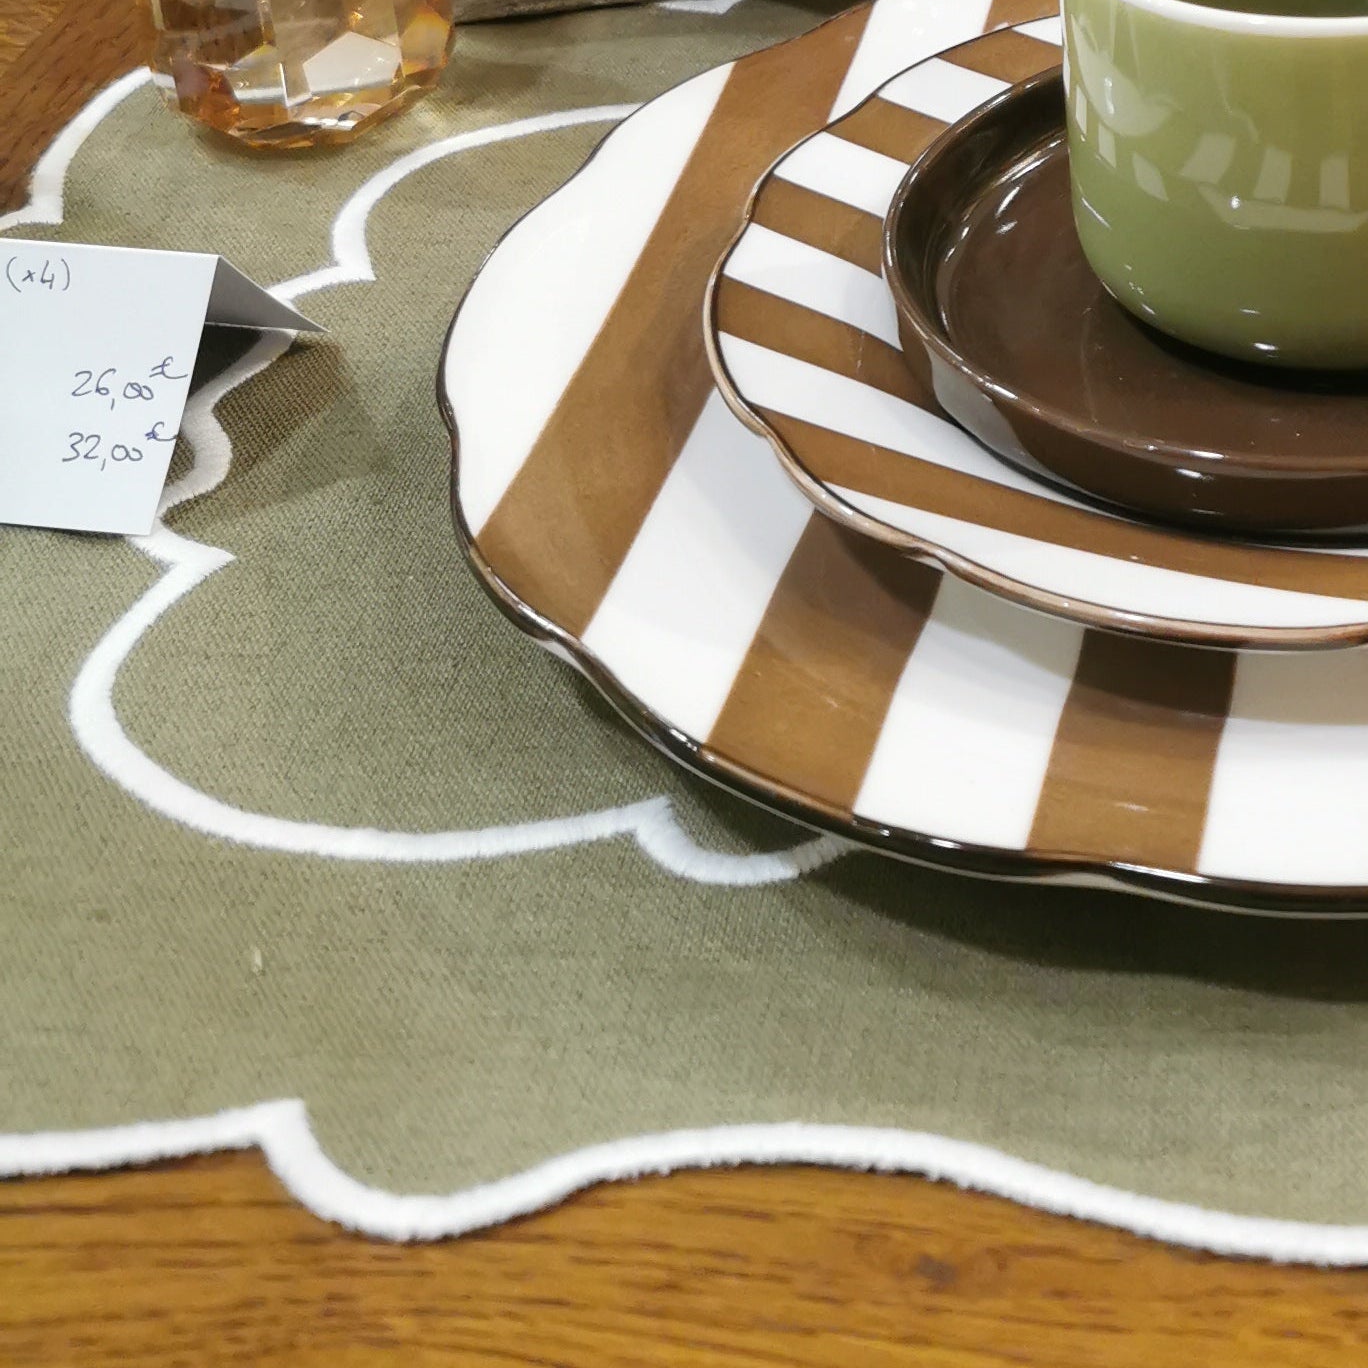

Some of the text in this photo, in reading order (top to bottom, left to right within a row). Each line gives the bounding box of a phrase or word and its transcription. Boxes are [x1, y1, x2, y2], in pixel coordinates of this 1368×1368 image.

[6, 256, 71, 292] (x4)
[71, 356, 189, 411] 26,00€
[62, 421, 178, 471] 32,00€
